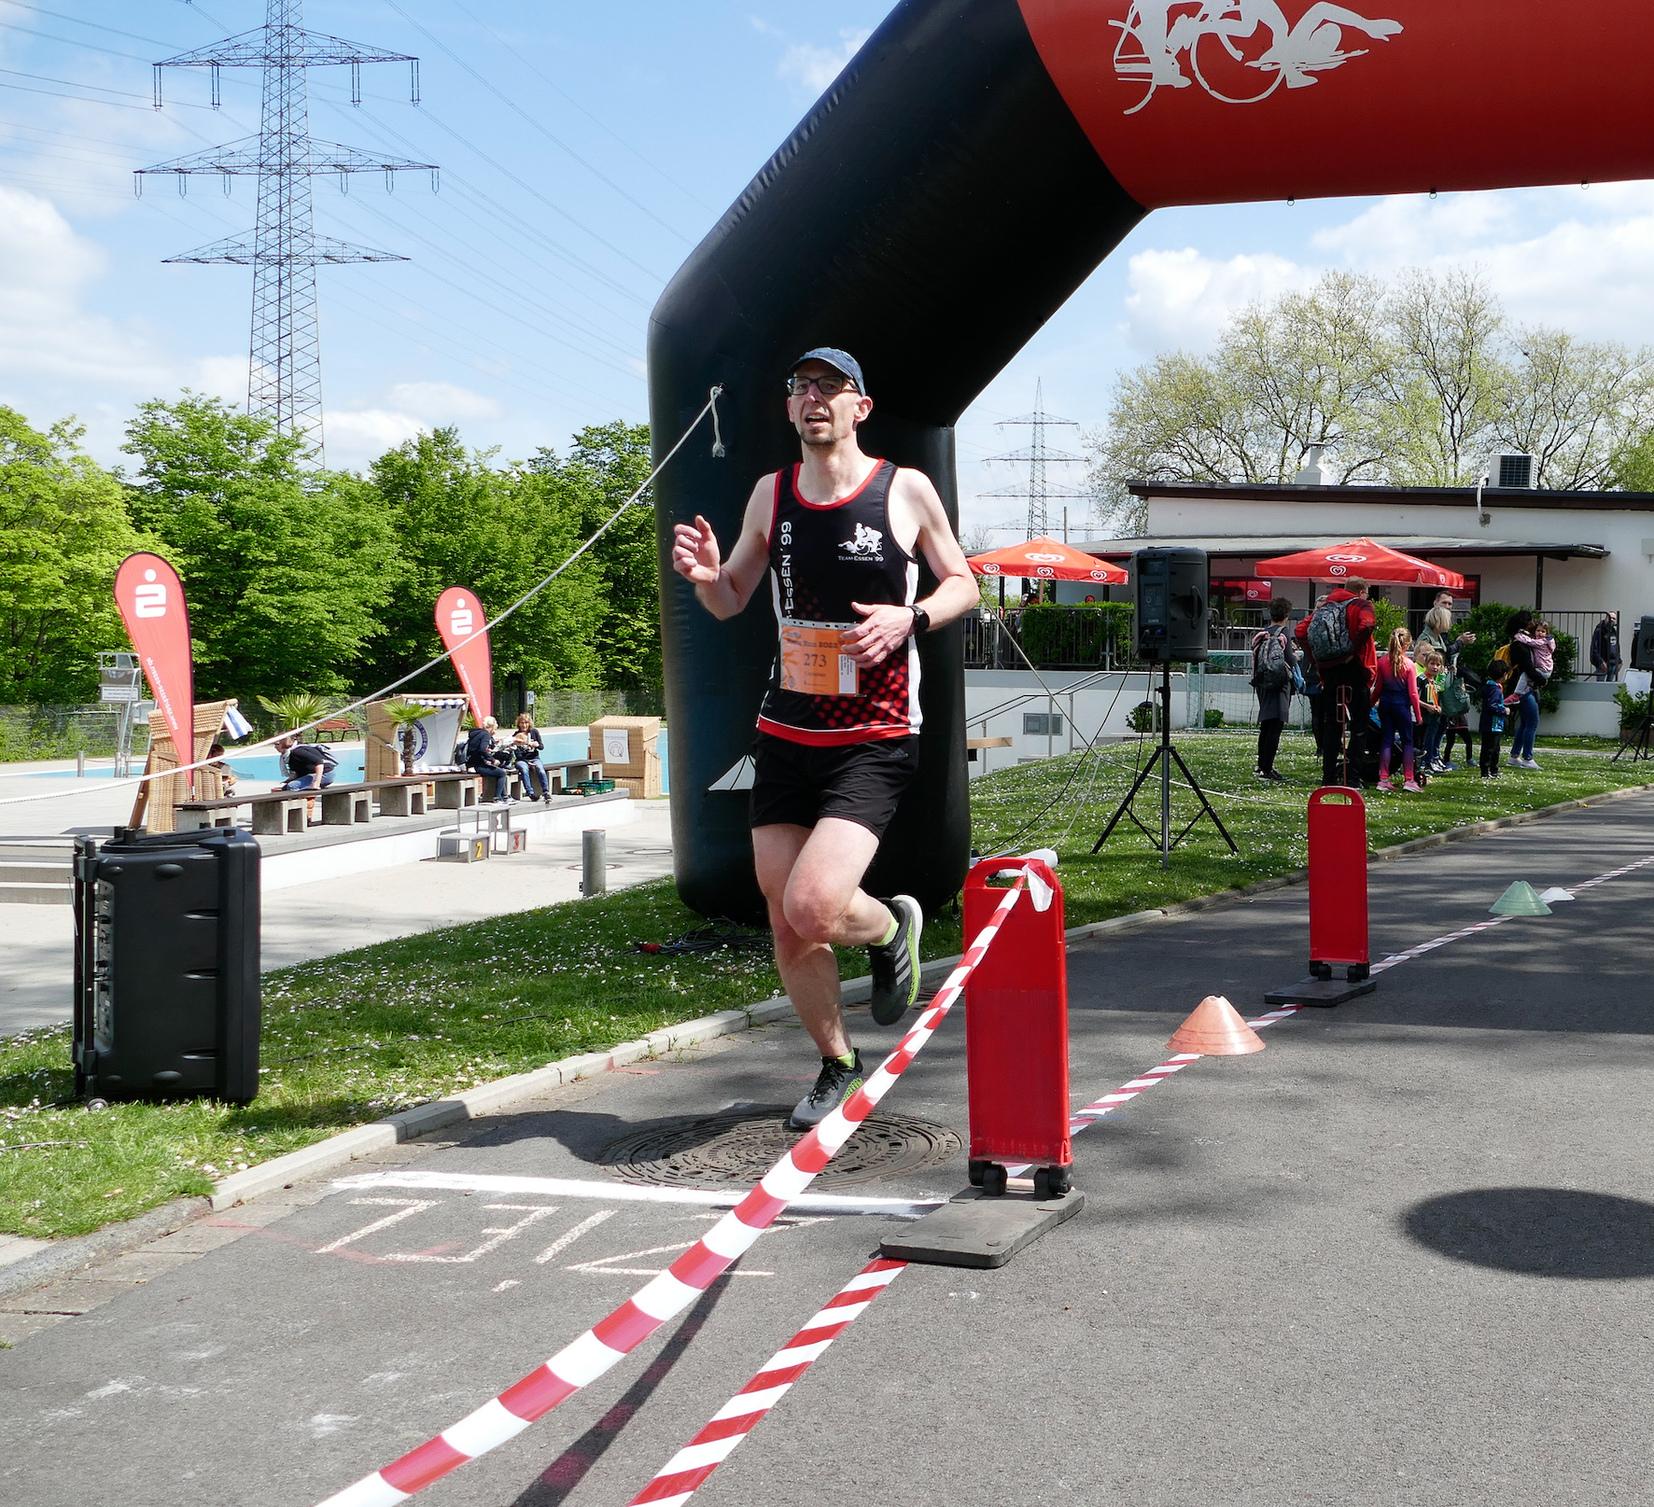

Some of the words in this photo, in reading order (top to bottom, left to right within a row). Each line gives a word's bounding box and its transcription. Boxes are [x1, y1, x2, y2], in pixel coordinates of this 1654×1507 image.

[804, 653, 827, 667] 273
[496, 813, 503, 829] 1
[475, 840, 483, 860] 2
[513, 832, 520, 852] 3
